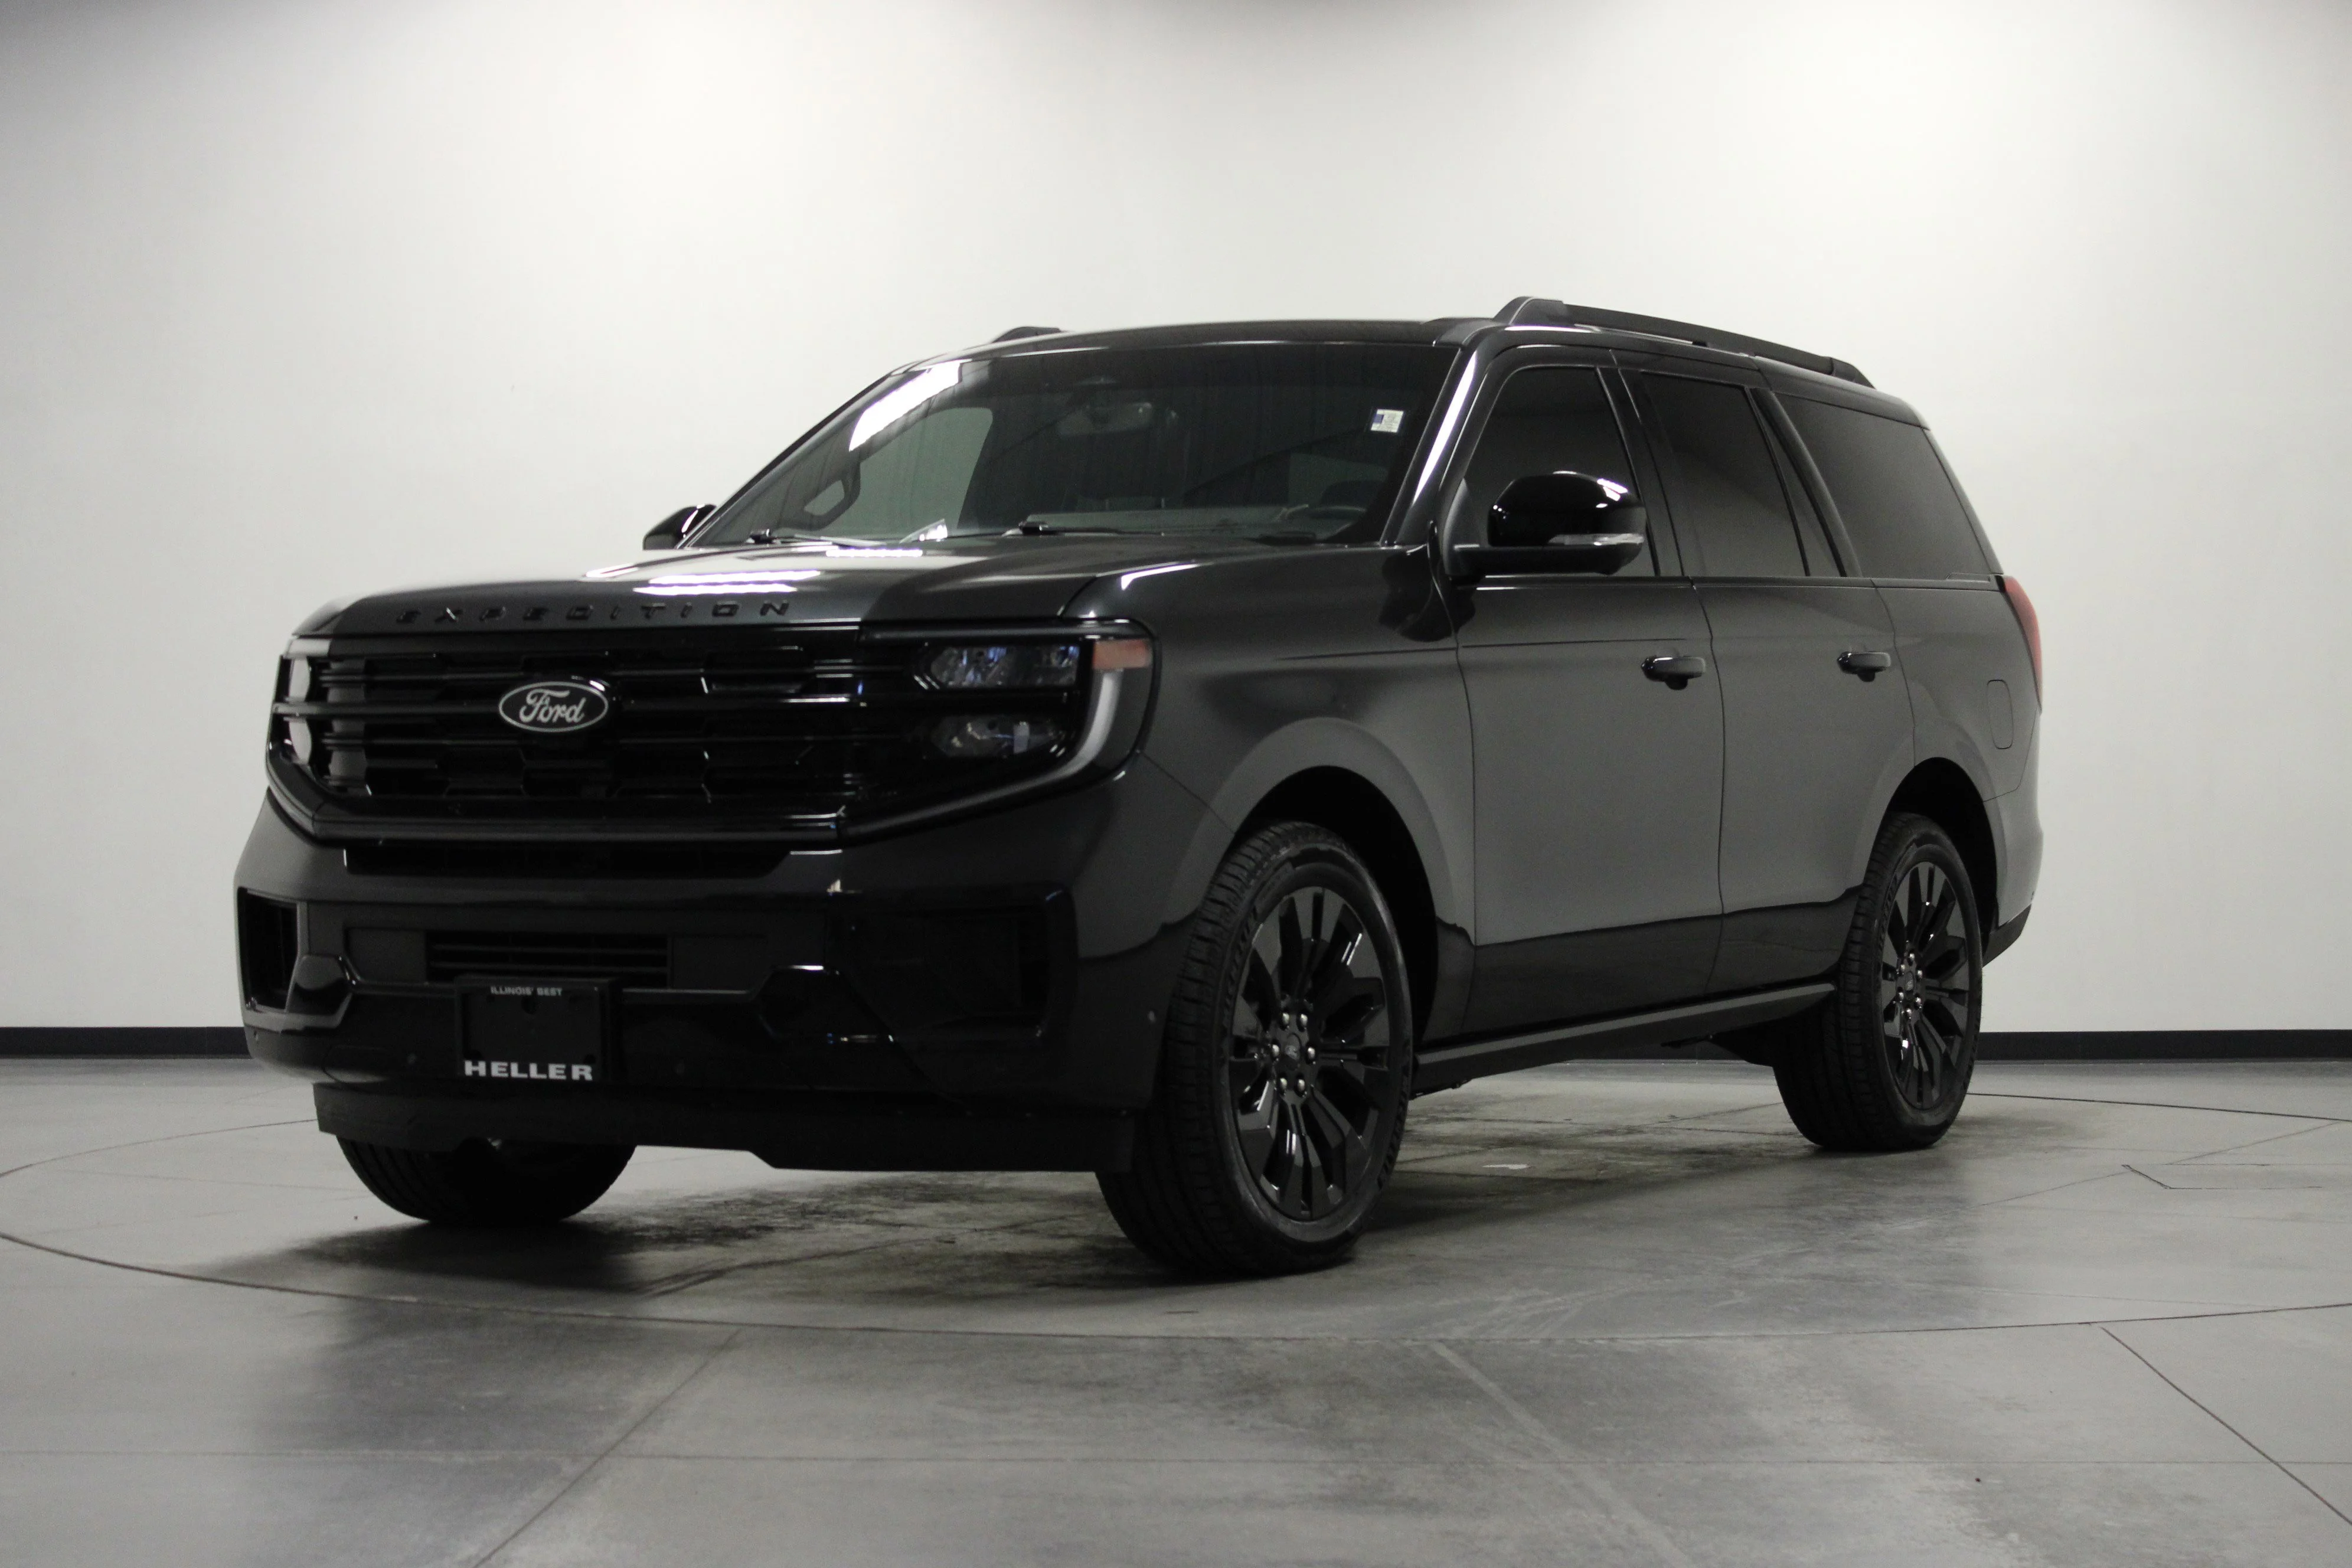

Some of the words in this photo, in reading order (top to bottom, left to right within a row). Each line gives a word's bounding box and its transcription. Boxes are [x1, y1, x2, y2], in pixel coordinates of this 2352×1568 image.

[396, 602, 789, 623] EXPEDITION
[519, 689, 586, 724] Ford
[537, 987, 562, 996] BEST
[465, 1060, 592, 1080] HELLER
